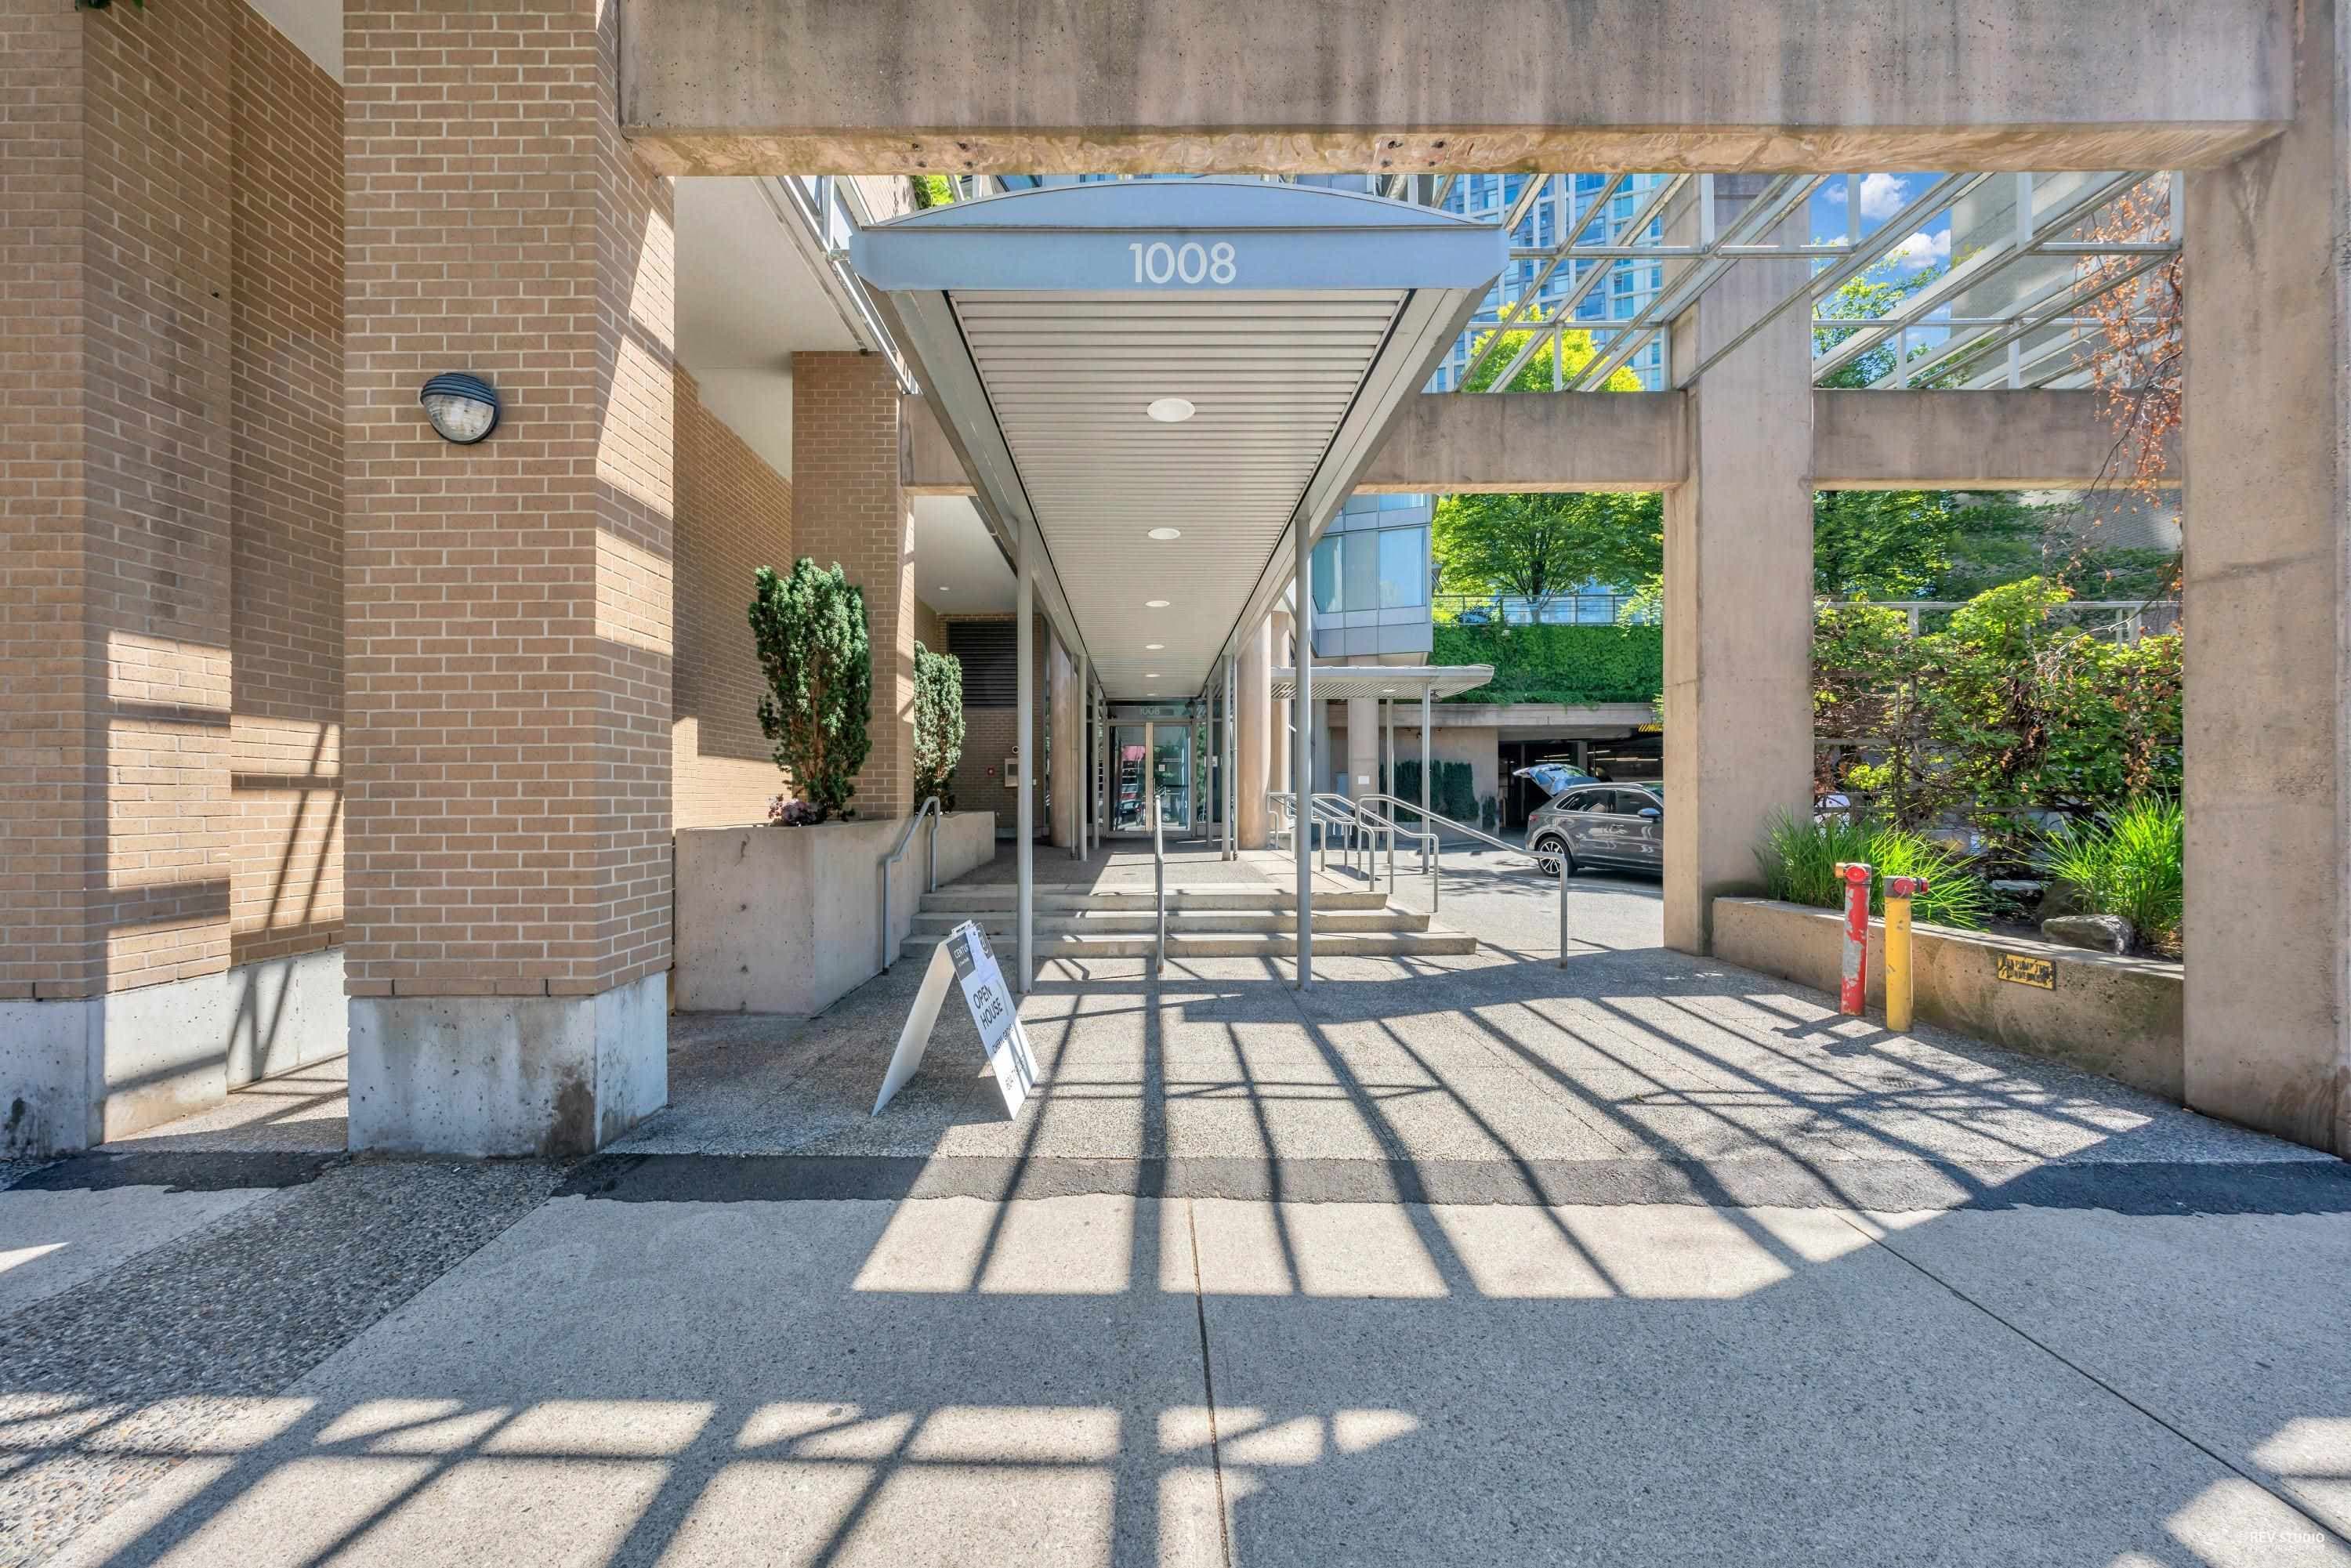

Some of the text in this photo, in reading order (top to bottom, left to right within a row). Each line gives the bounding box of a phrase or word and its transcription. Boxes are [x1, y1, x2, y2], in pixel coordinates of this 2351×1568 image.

[1128, 242, 1236, 284] 1008
[1140, 707, 1161, 715] 1008
[973, 984, 993, 1009] OPEN
[980, 997, 1003, 1030] HOUSE
